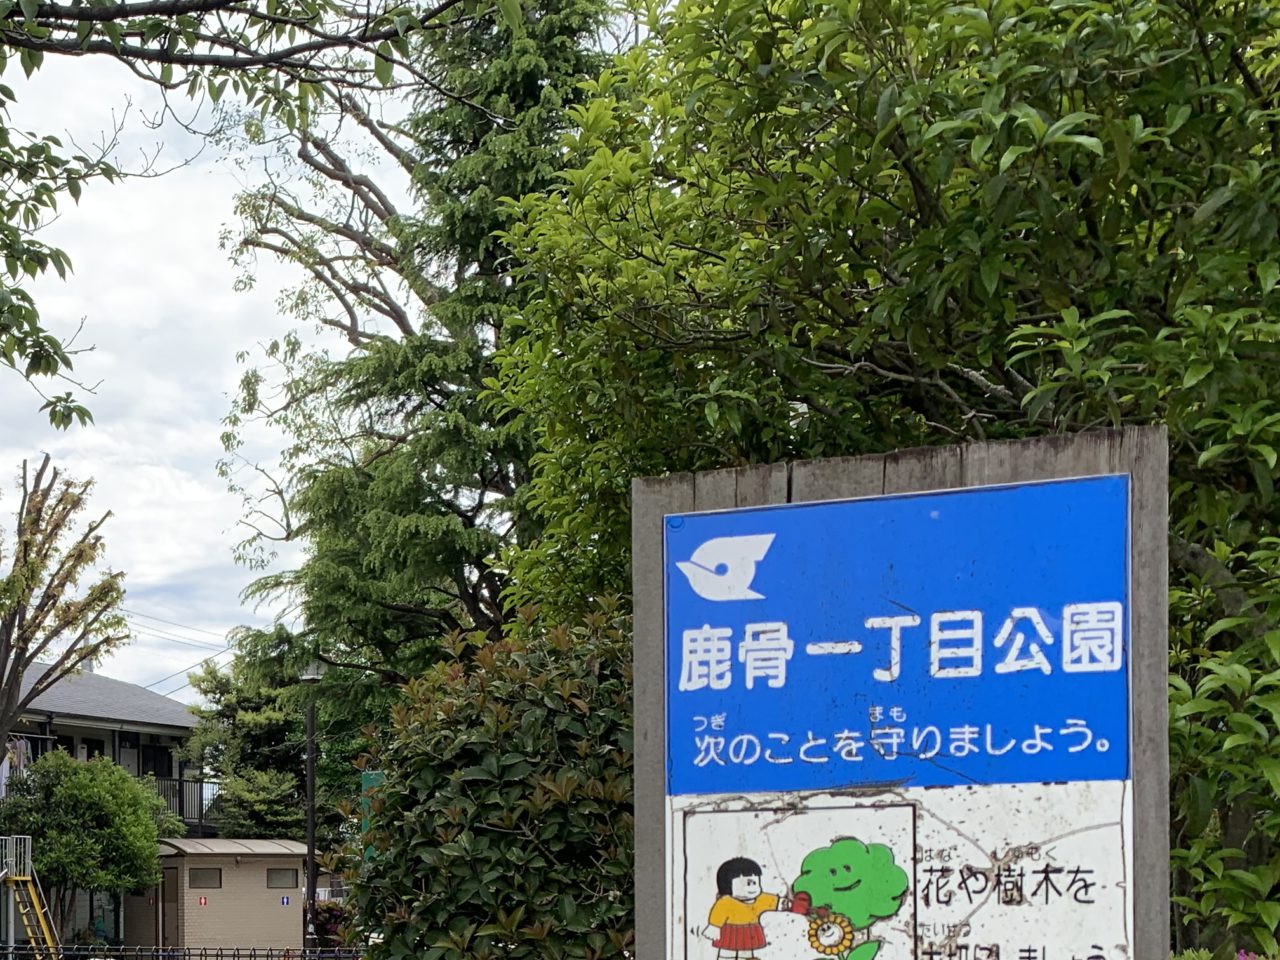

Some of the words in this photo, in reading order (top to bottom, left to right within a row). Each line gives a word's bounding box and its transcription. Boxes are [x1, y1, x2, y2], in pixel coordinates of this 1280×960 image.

[678, 601, 1122, 692] 鹿骨一丁目公園
[693, 713, 726, 731] つぎ
[870, 706, 907, 722] まも
[693, 718, 1110, 767] 次のことを守りましょう。
[921, 864, 1096, 907] 花や樹木を
